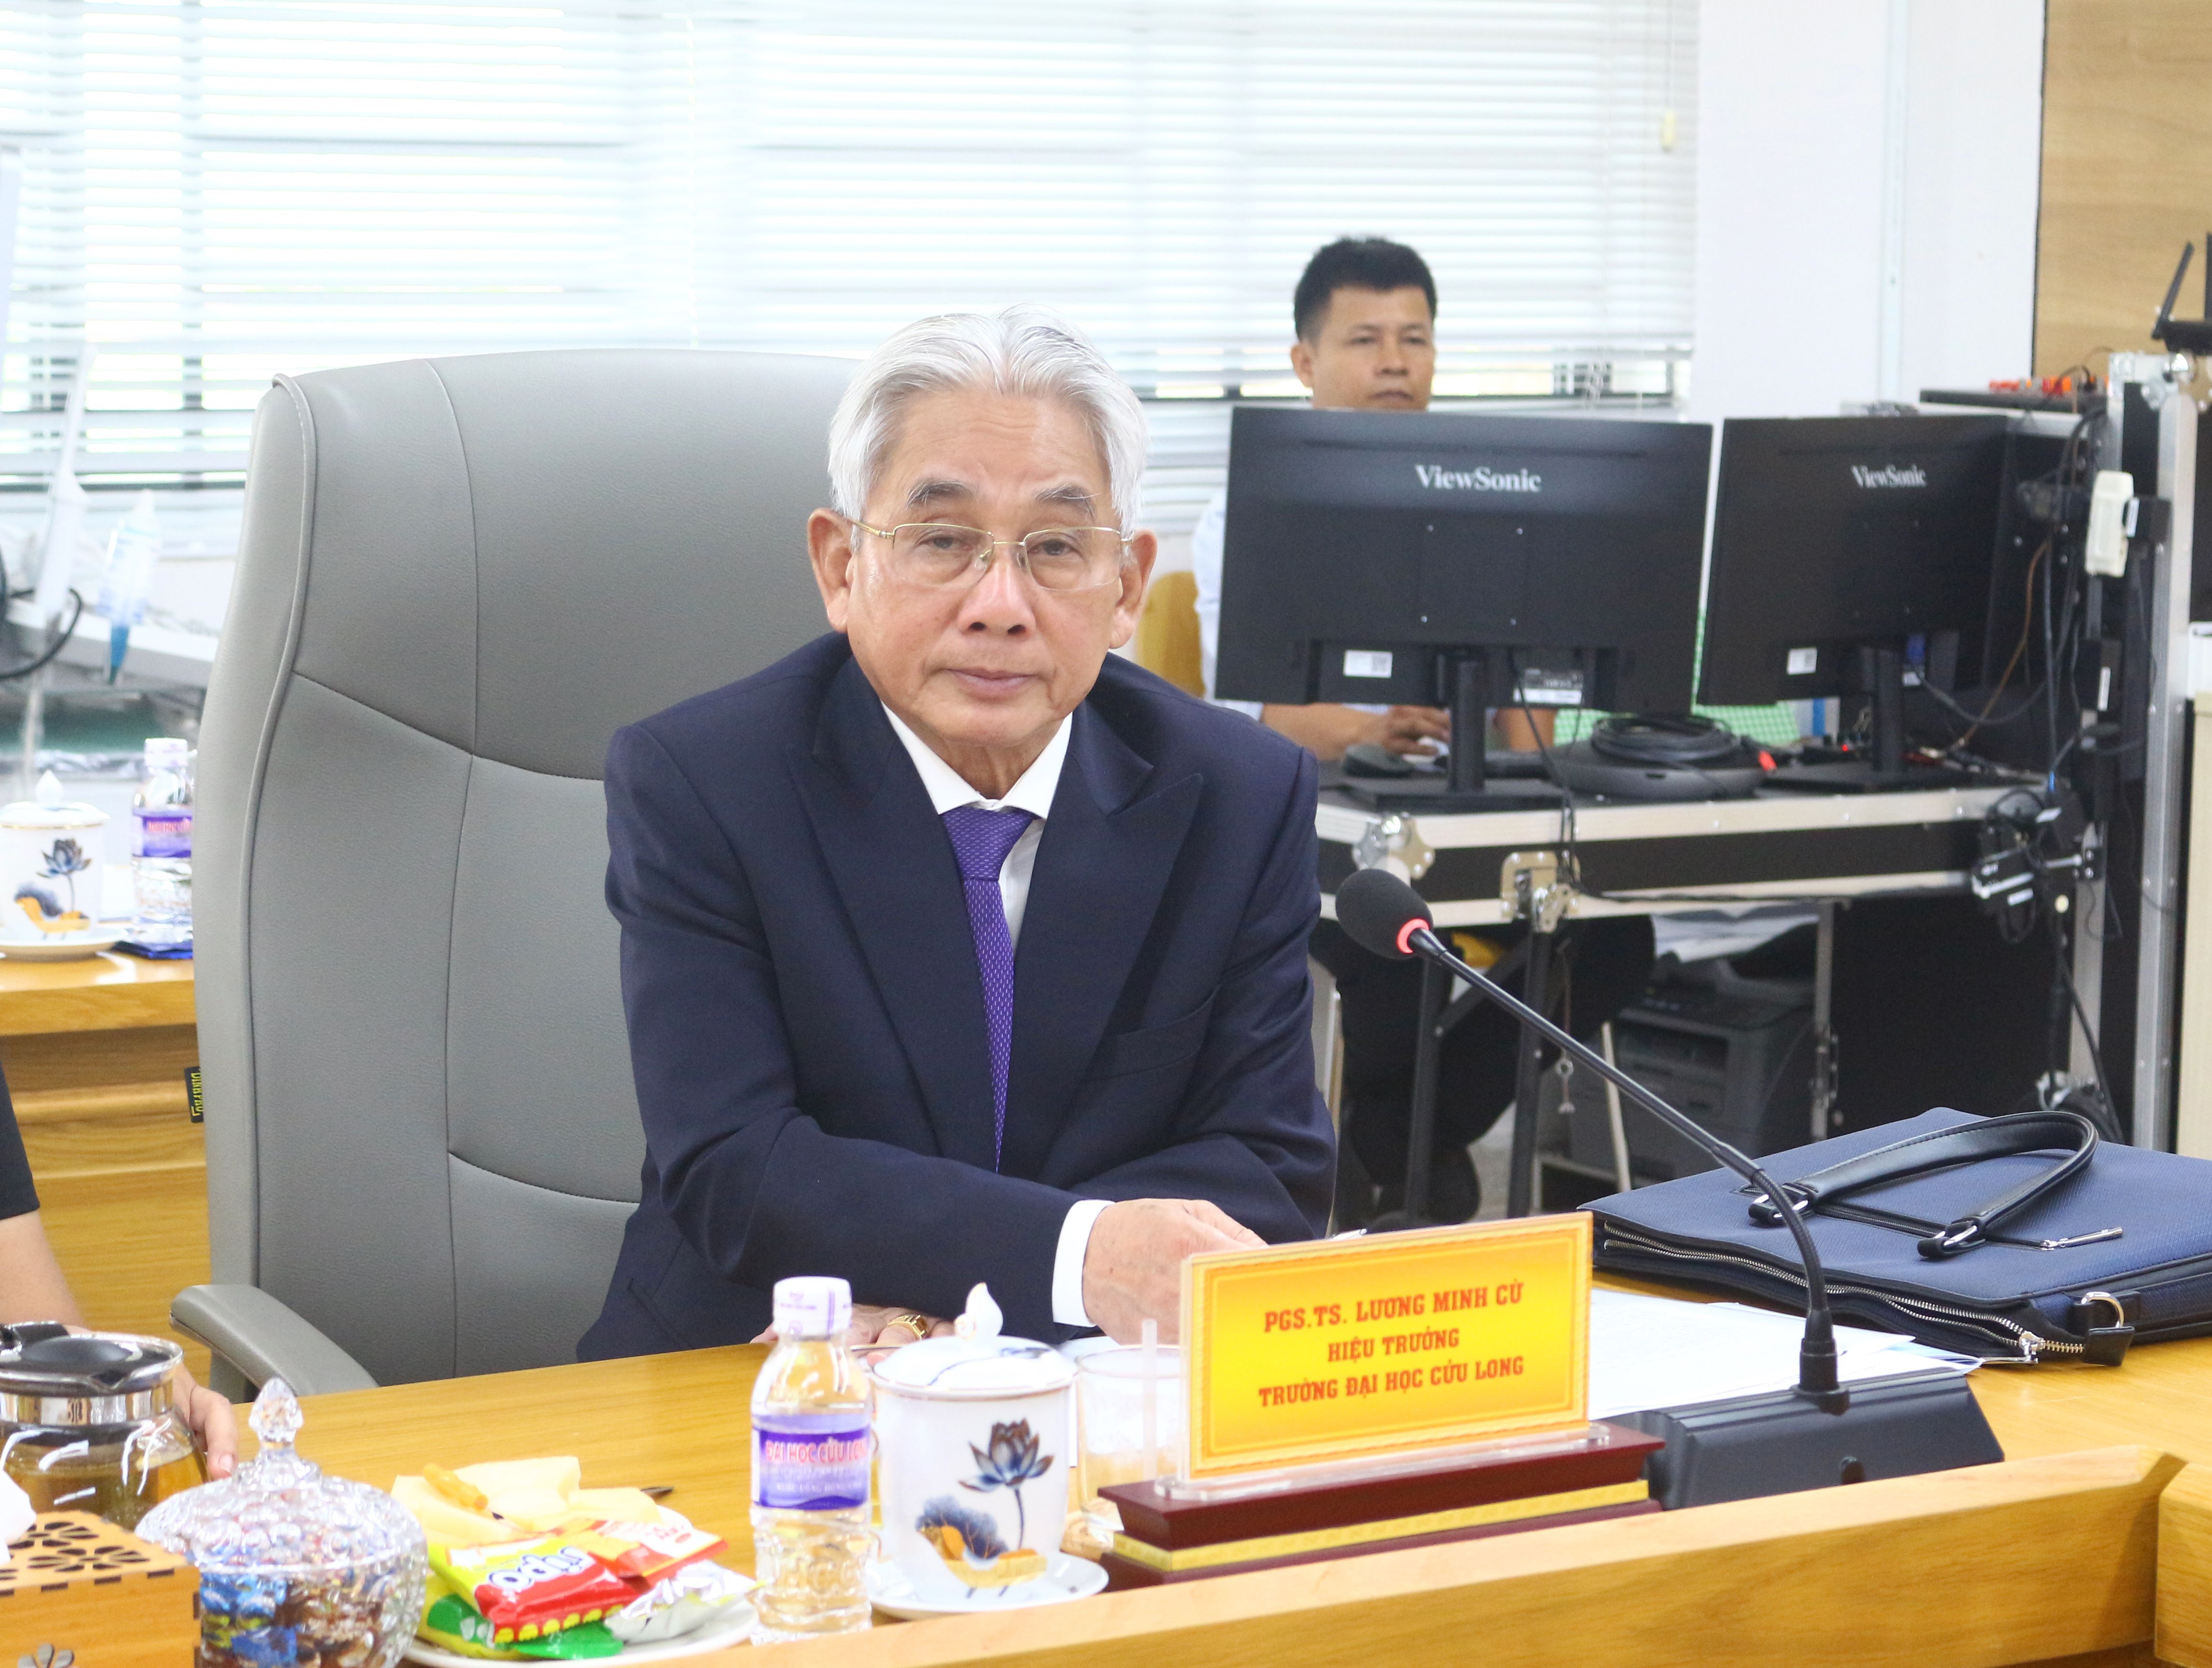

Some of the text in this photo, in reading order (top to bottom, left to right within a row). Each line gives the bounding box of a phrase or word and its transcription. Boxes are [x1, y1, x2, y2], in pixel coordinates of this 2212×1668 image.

[1414, 463, 1542, 493] ViewSonic
[1851, 464, 1927, 488] ViewSonic
[1265, 1304, 1347, 1333] PGS.TS.
[1356, 1294, 1425, 1322] LƯƠNG
[1433, 1286, 1488, 1313] MINH
[1328, 1326, 1460, 1363] HIỆU TRƯỞNG
[1259, 1355, 1524, 1407] TRƯỜNG ĐẠI HỌC CỬU LONG
